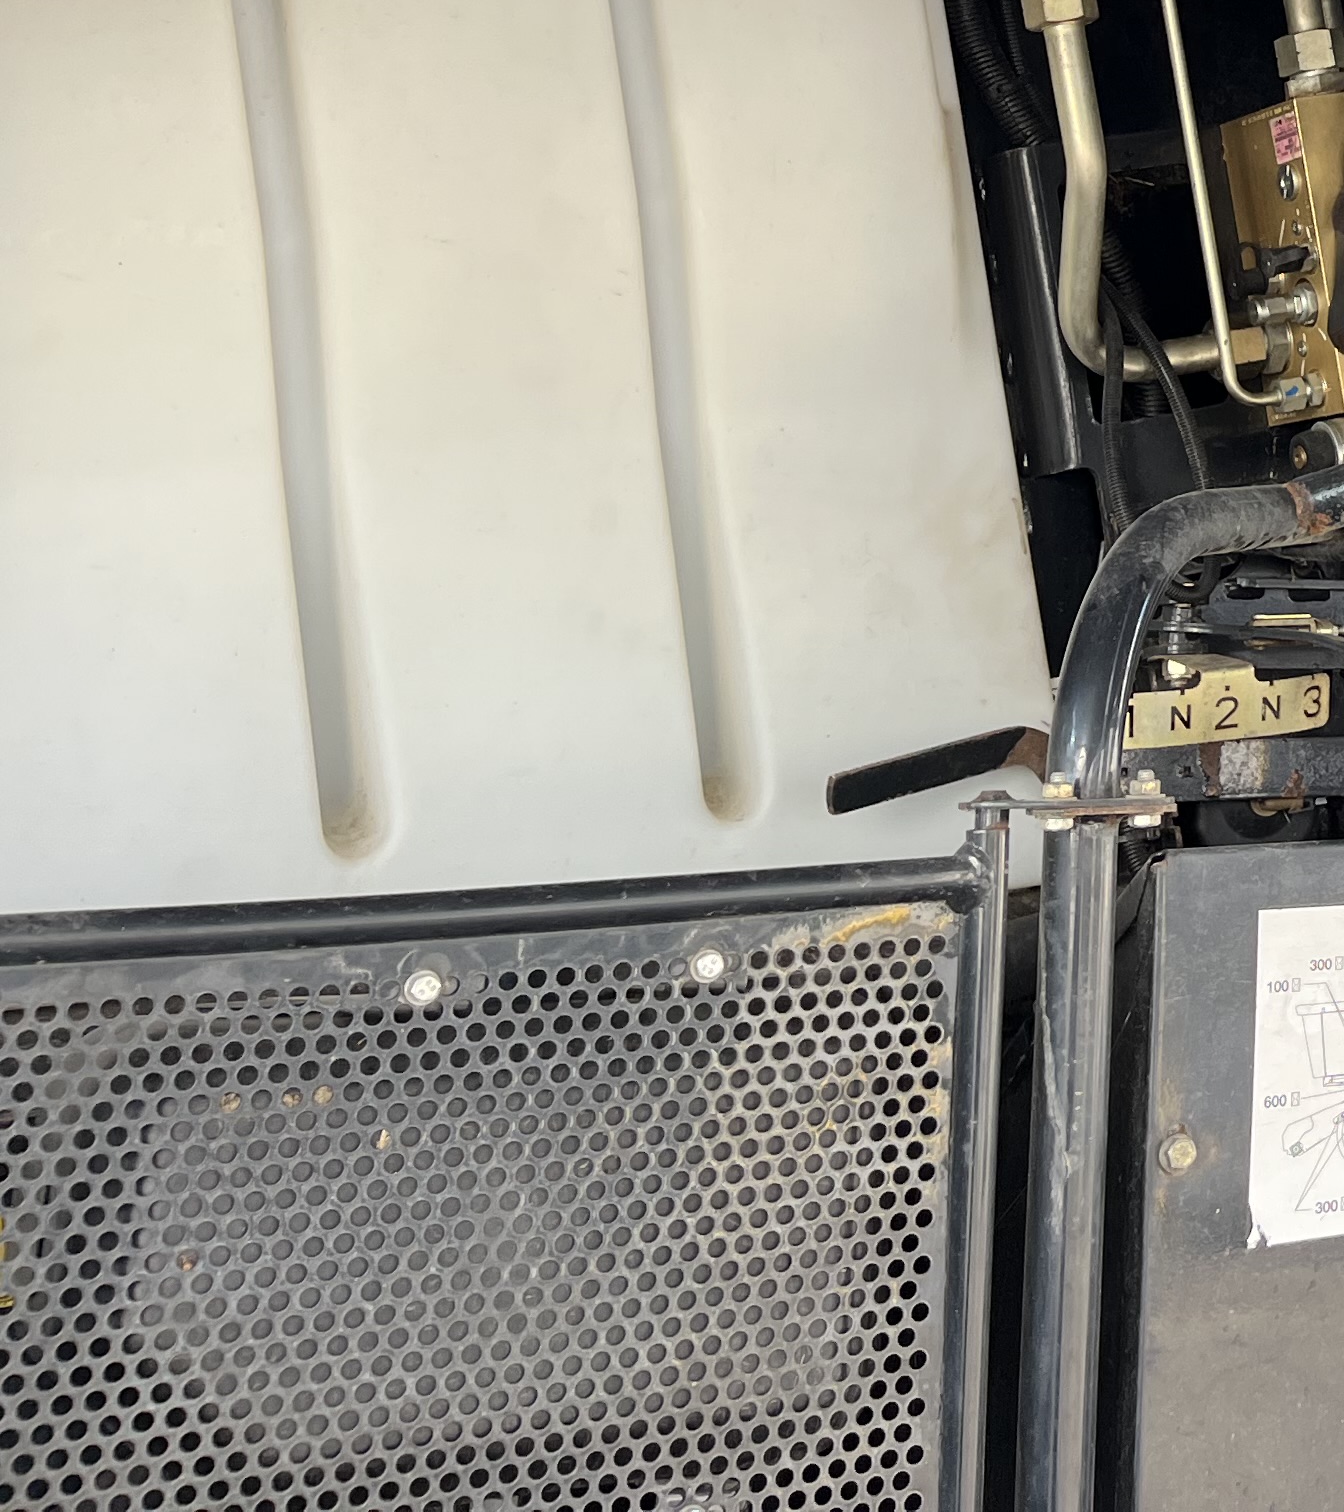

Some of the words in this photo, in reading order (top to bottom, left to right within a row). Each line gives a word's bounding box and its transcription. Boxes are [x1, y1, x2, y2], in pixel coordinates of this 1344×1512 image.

[1170, 704, 1192, 731] N
[1214, 696, 1239, 731] 2
[1261, 694, 1281, 722] N
[1302, 685, 1322, 718] 3
[1309, 957, 1332, 972] 300
[1266, 979, 1289, 993] 100
[1263, 1094, 1287, 1108] 600
[1314, 1199, 1338, 1214] 300
